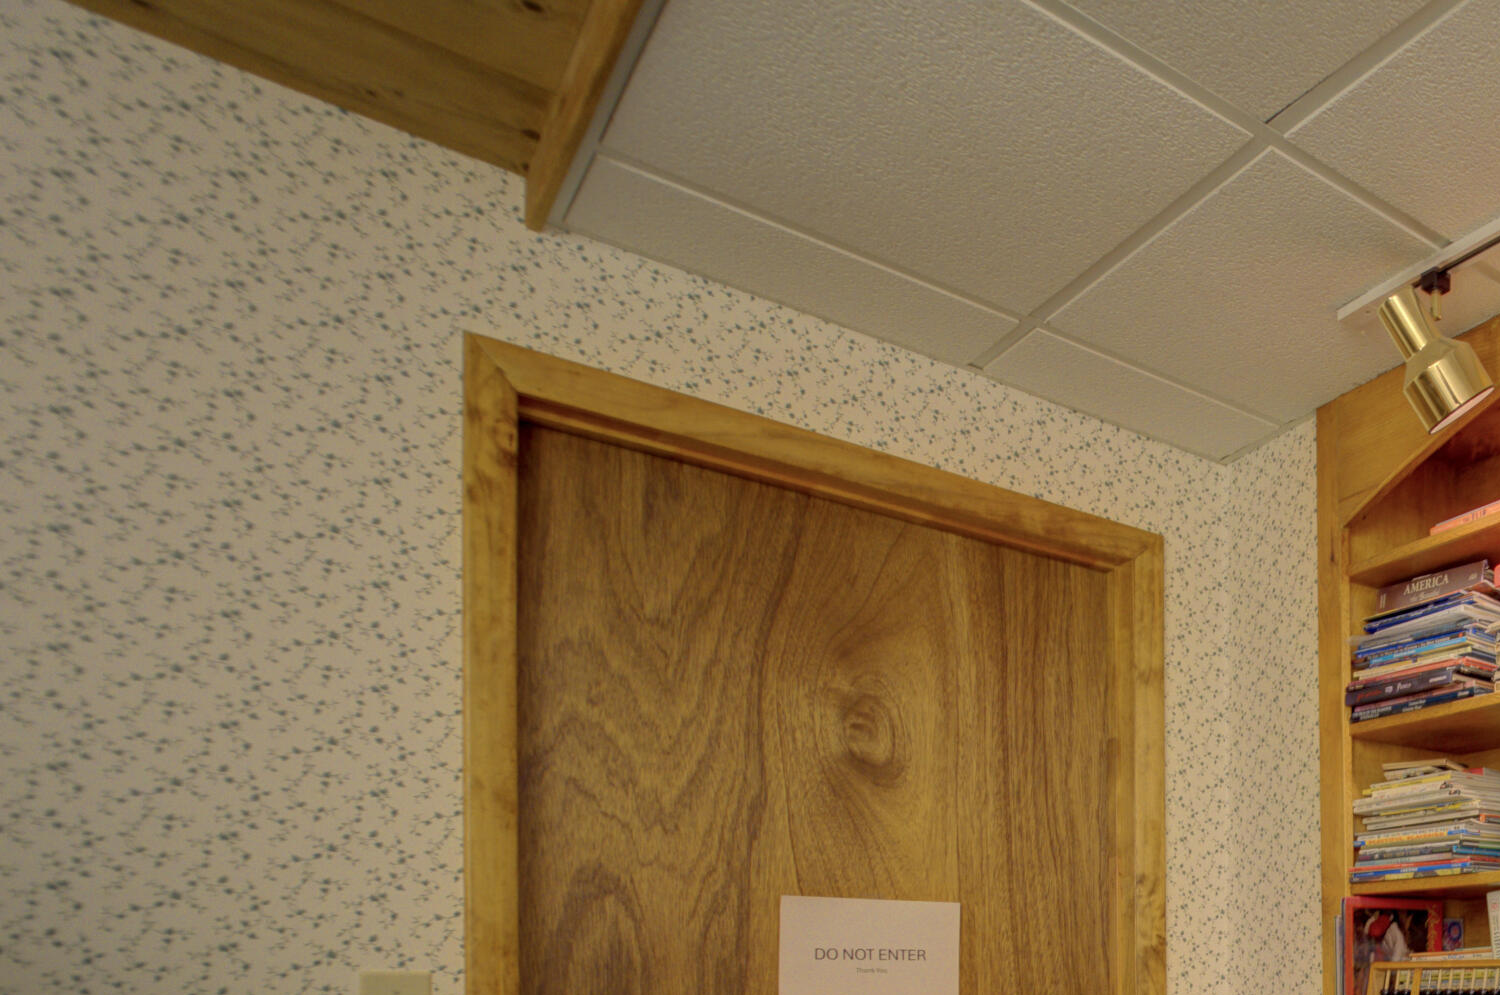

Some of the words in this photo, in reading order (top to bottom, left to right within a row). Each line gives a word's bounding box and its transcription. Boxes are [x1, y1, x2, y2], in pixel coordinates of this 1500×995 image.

[1403, 573, 1449, 596] AMERICA
[814, 947, 839, 961] DO
[843, 947, 875, 961] NOT
[879, 948, 926, 961] ENTER
